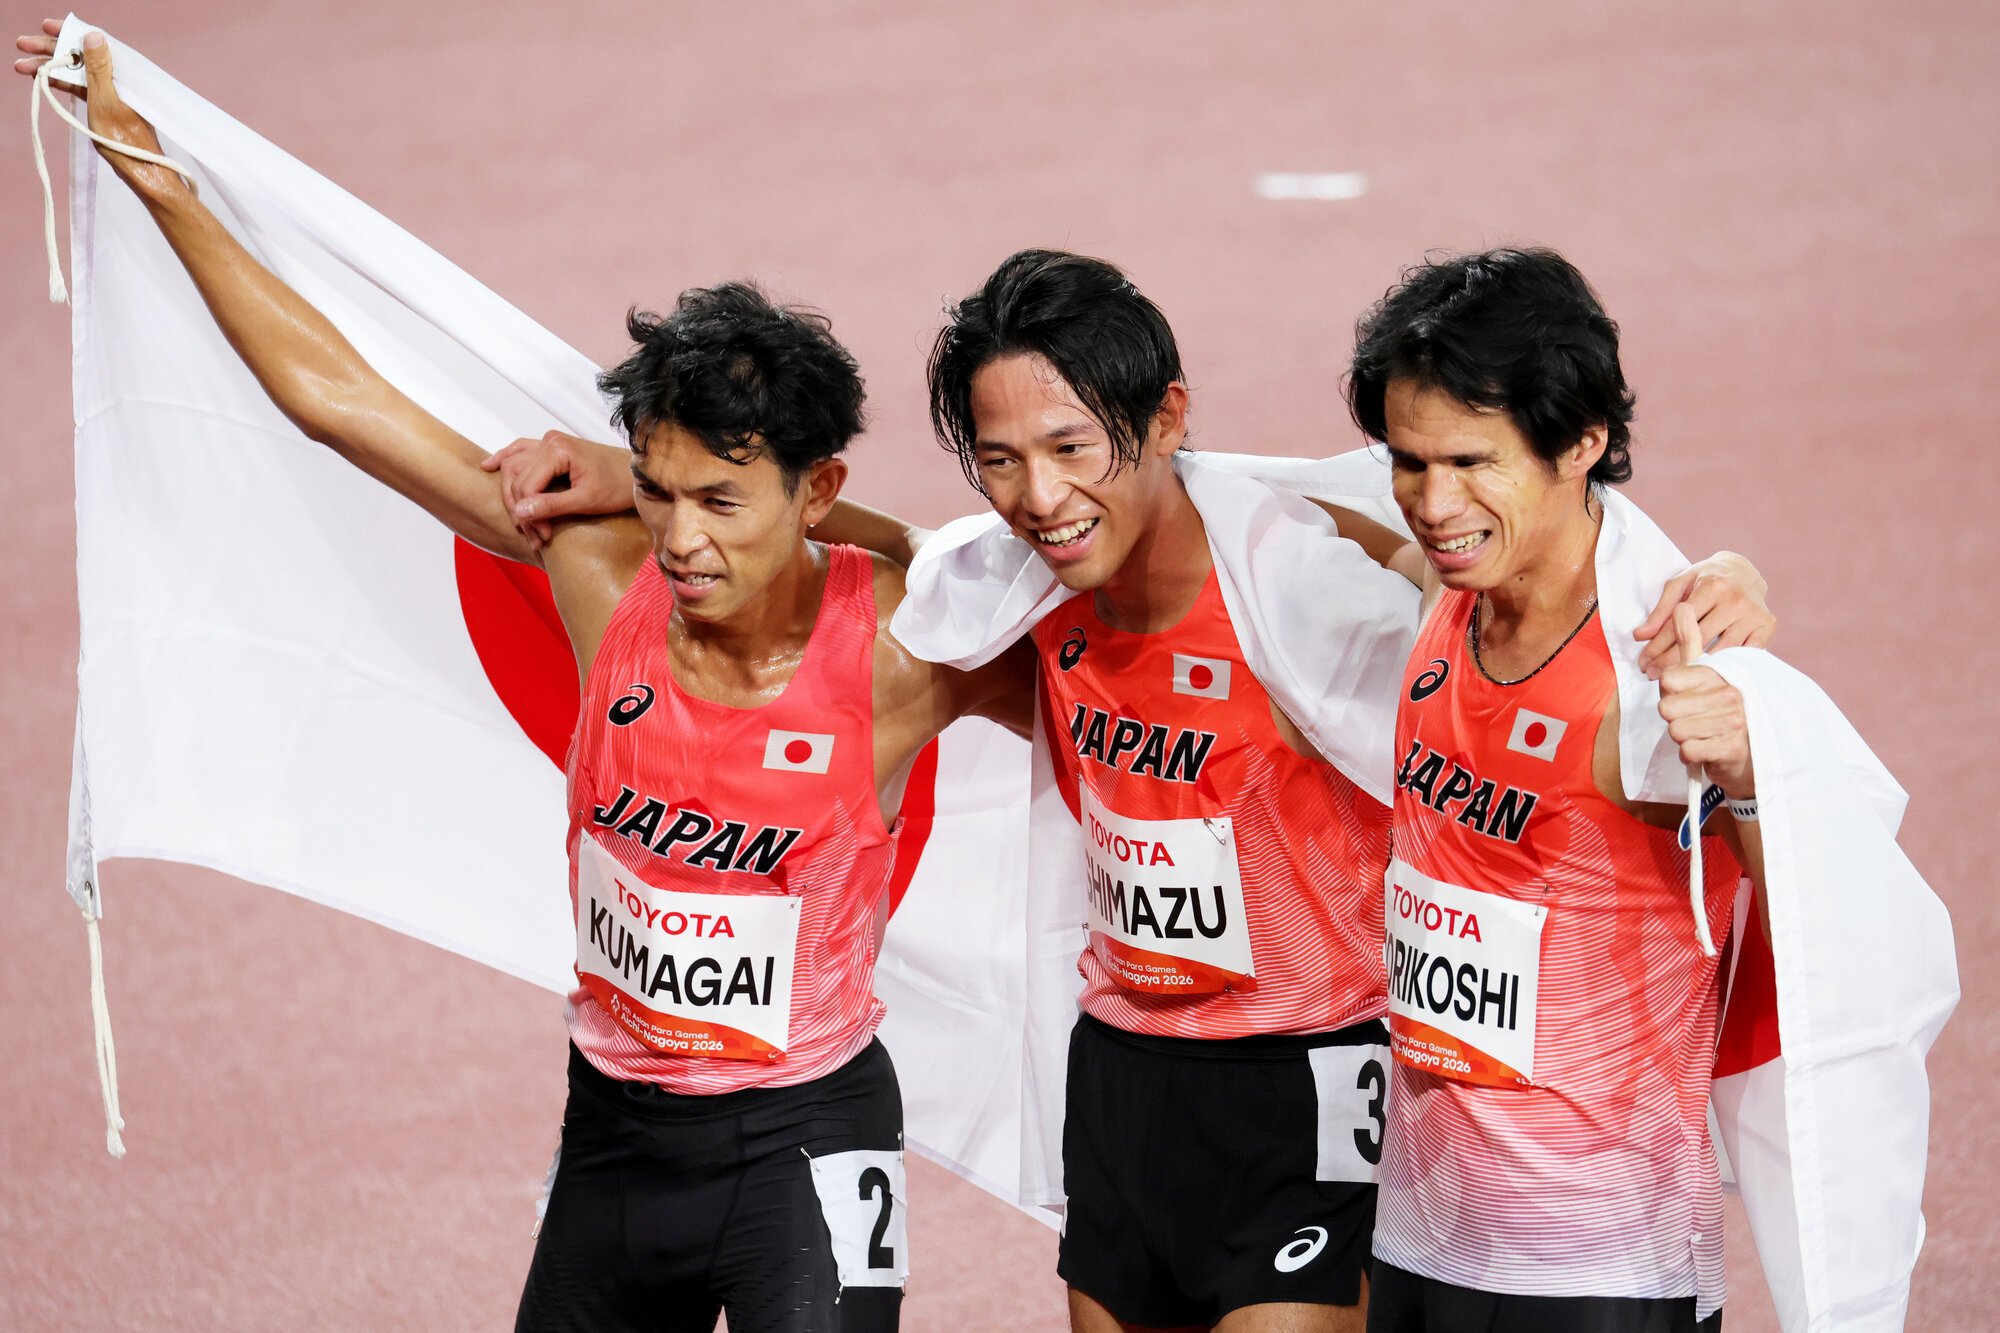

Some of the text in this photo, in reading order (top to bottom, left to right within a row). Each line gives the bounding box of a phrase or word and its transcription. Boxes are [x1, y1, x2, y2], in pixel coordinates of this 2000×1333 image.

[1070, 702, 1217, 784] JAPAN
[1396, 737, 1540, 844] JAPAN
[593, 783, 804, 875] JAPAN
[1089, 812, 1175, 867] TOYOTA
[614, 878, 735, 938] TOYOTA
[1393, 883, 1482, 943] TOYOTA
[591, 897, 774, 1006] KUMAGAI
[1126, 960, 1143, 971] Para
[1145, 965, 1177, 974] Games
[1163, 975, 1194, 985] 2026
[1385, 928, 1519, 1031] ORIKOSHI
[620, 1012, 724, 1051] Aichi-Nagoya 2026
[632, 1012, 650, 1029] Asian
[651, 1024, 673, 1037] Para
[674, 1030, 709, 1040] Games
[1408, 1037, 1427, 1049] Para
[1428, 1043, 1458, 1058] Games
[1442, 1057, 1471, 1074] 2026
[1353, 1058, 1386, 1166] 3
[858, 1166, 894, 1269] 2
